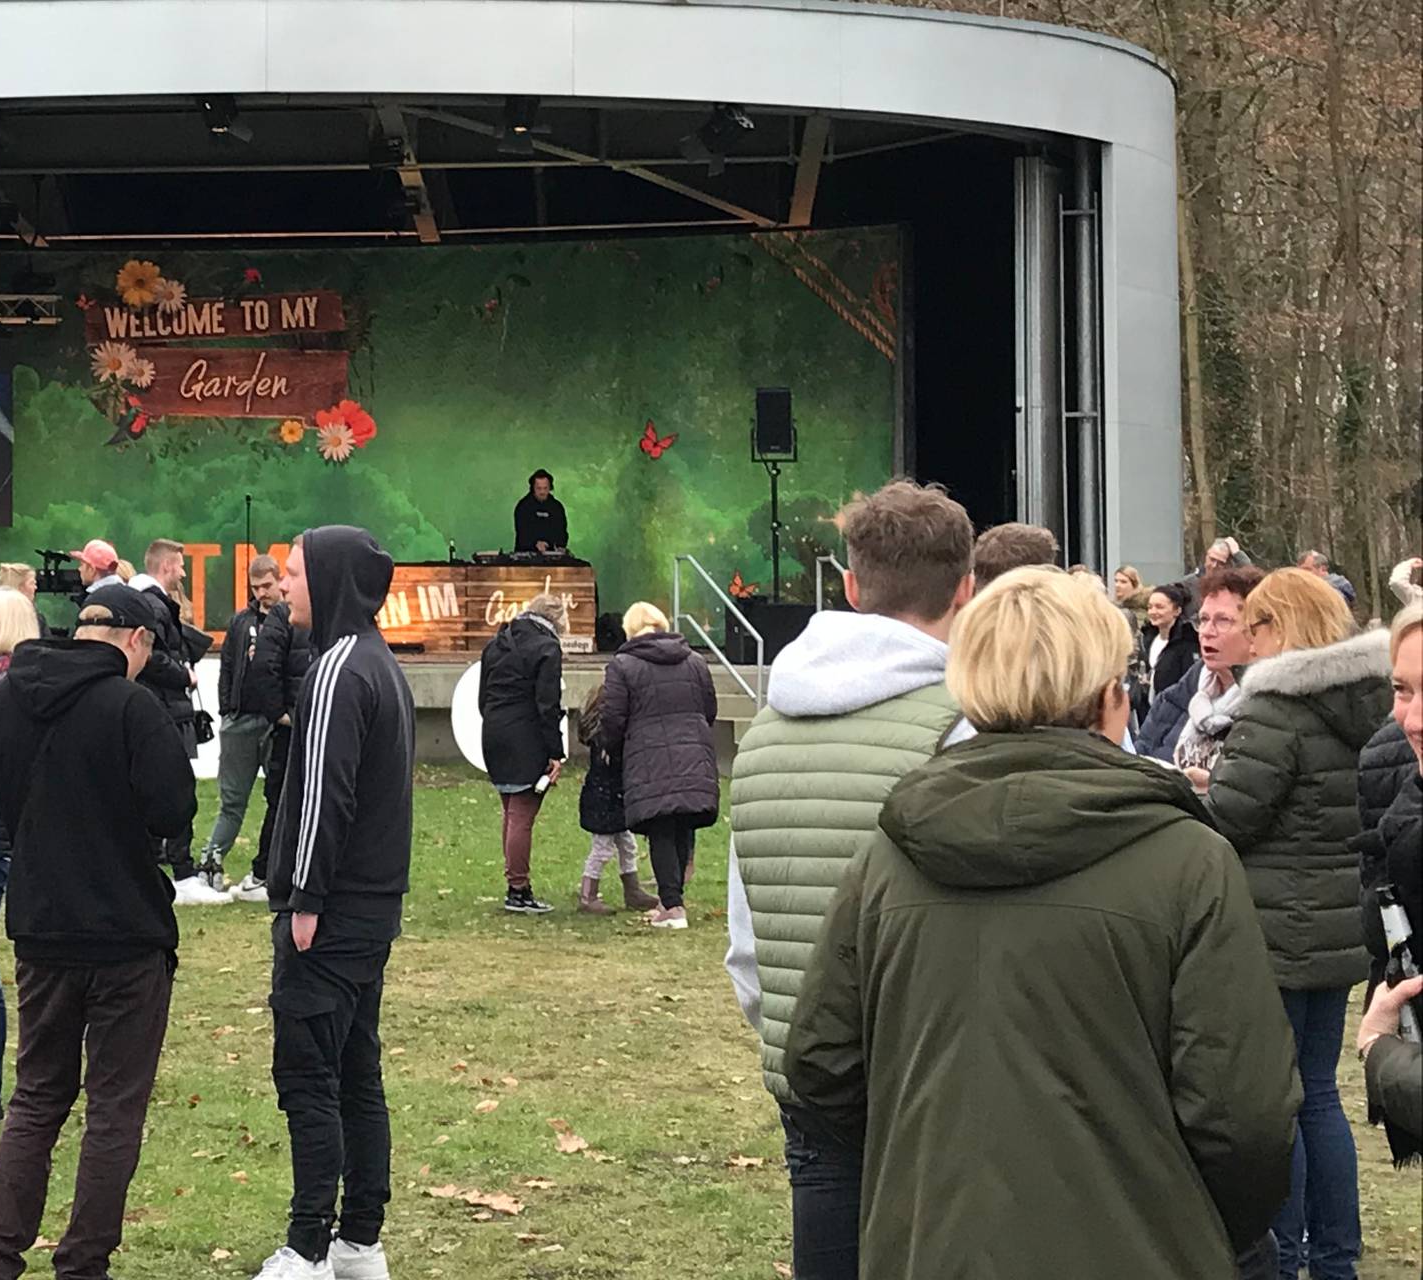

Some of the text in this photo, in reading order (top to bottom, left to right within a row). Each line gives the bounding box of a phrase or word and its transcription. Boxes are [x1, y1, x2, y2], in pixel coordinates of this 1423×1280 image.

[104, 296, 319, 339] WELCOME TO MY
[180, 352, 289, 413] Garden
[417, 582, 460, 622] IM
